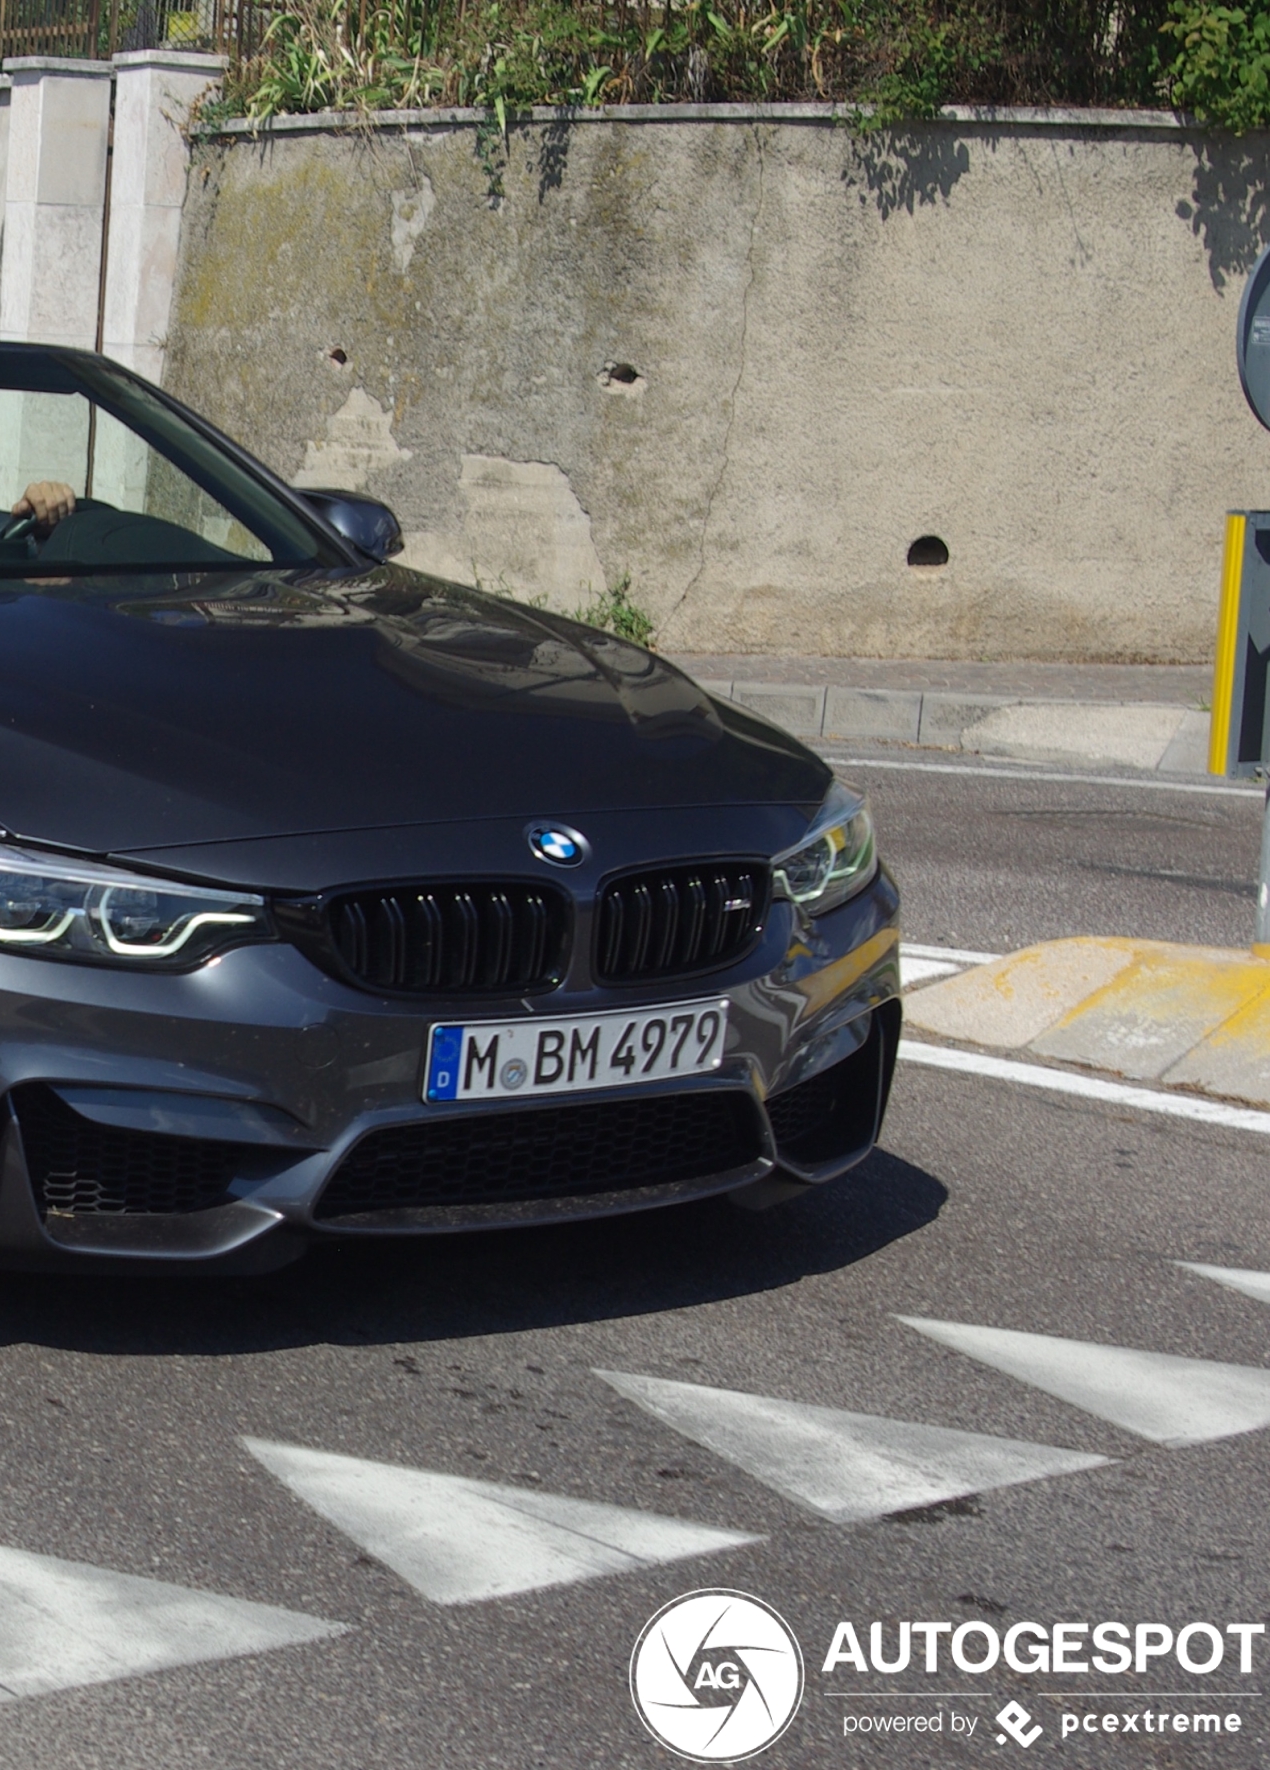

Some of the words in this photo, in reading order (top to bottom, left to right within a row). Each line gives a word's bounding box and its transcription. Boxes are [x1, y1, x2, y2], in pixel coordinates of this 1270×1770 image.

[463, 1034, 499, 1090] M
[533, 1025, 600, 1086] BM
[610, 1010, 721, 1076] 4979
[436, 1072, 450, 1088] D
